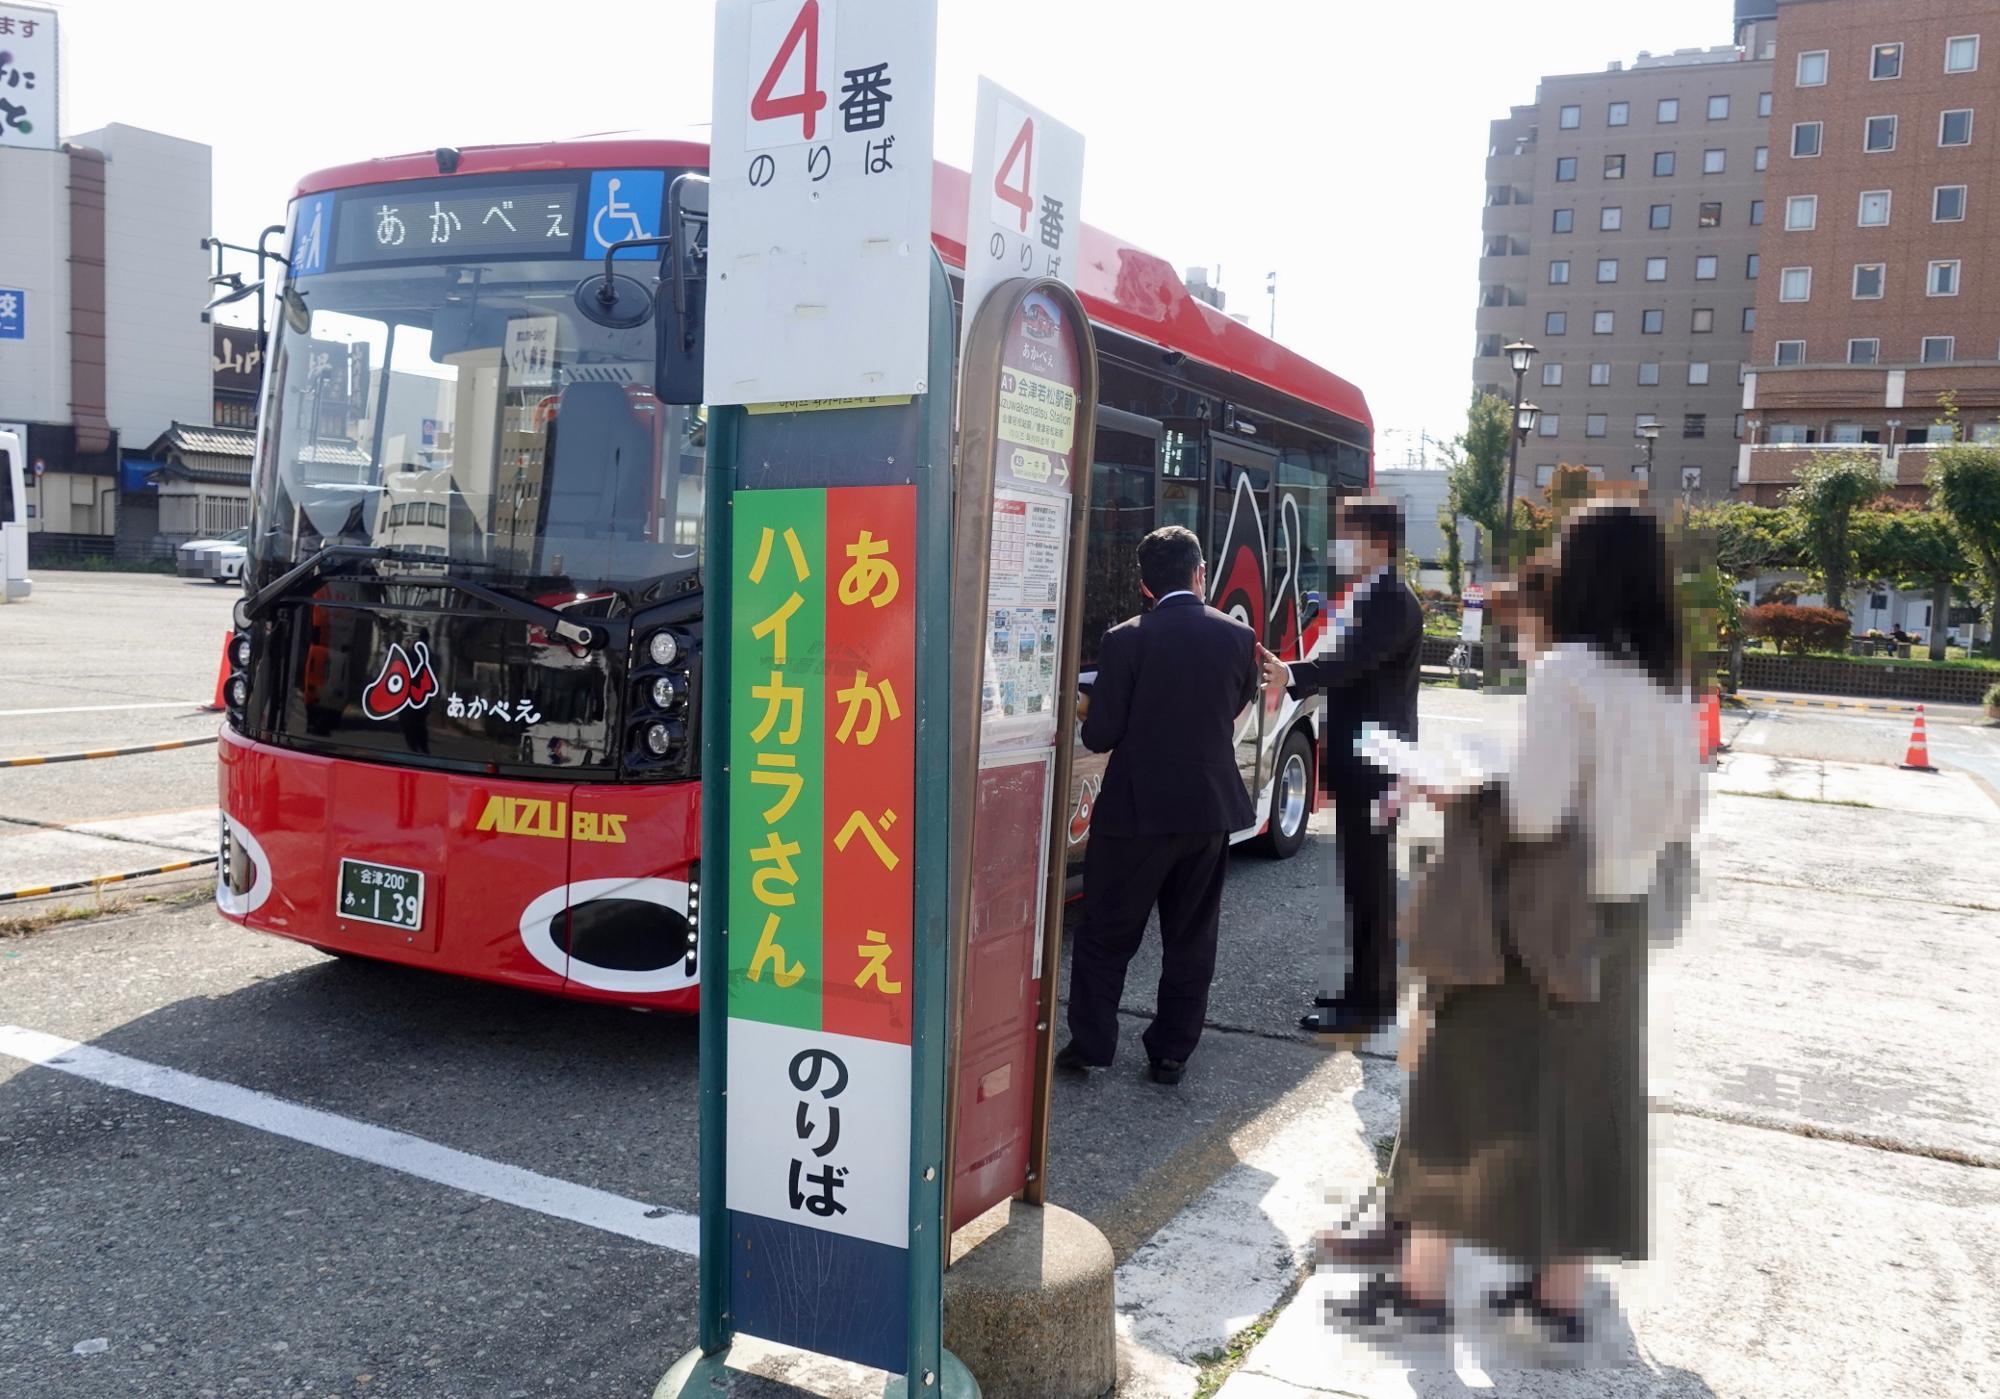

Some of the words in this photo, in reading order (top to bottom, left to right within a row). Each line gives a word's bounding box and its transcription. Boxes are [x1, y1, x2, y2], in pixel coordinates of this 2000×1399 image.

[749, 135, 895, 187] のりば
[1018, 377, 1073, 411] 会津若松駅前
[746, 527, 810, 987] ハイカラさん
[476, 796, 566, 839] AIZU
[572, 811, 628, 843] BUS
[788, 1048, 849, 1217] のりば
